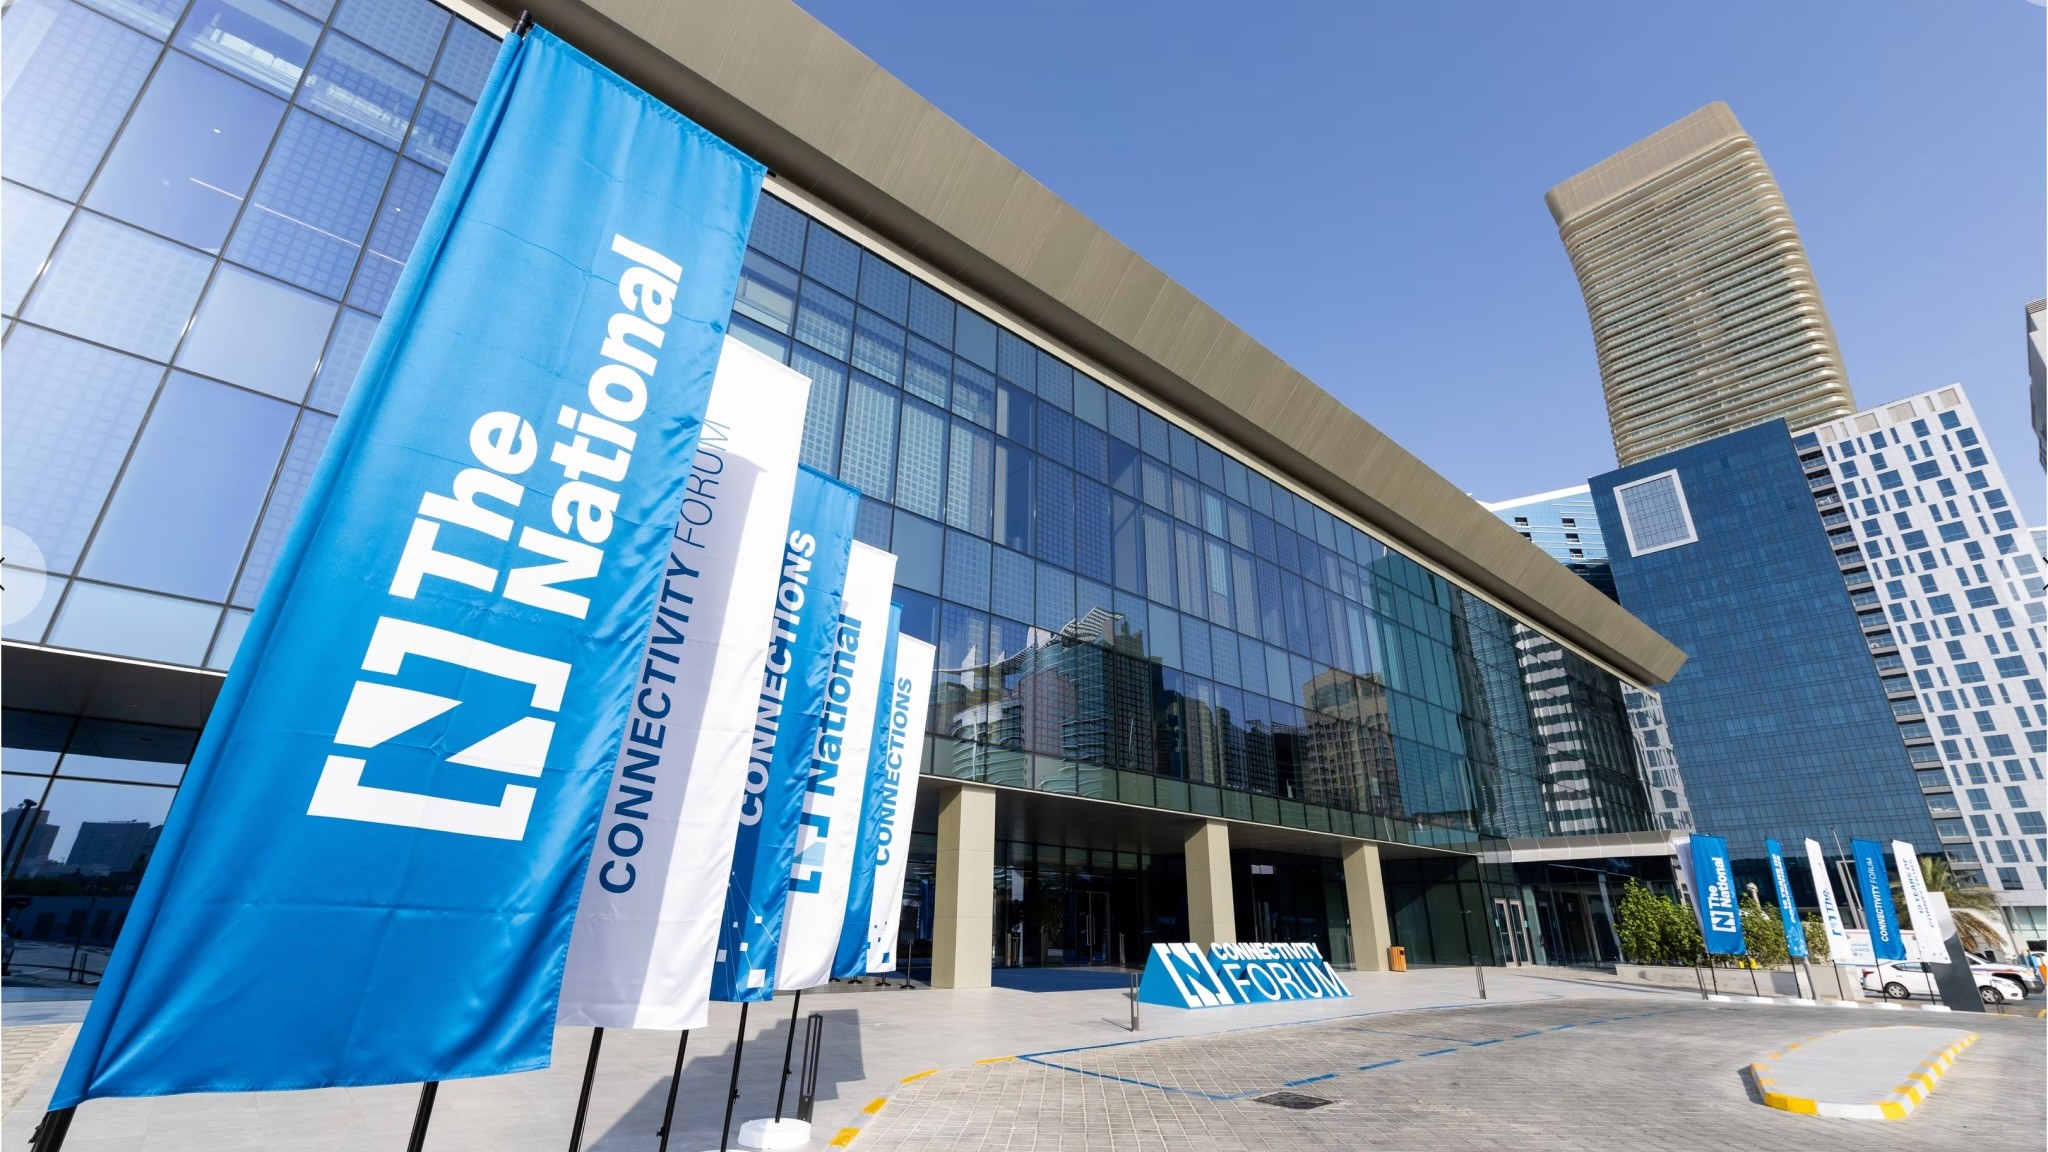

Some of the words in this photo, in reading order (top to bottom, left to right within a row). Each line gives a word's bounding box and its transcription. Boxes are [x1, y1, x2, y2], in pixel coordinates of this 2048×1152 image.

[502, 234, 683, 620] National
[388, 410, 538, 599] The
[599, 551, 700, 893] CONNECTIVITY
[674, 419, 731, 548] FORUM
[740, 529, 816, 826] CONNECTIONS
[806, 614, 862, 796] National
[875, 677, 912, 866] CONNECTIONS
[1708, 885, 1719, 909] The
[1711, 857, 1733, 908] National
[1865, 857, 1877, 883] FORUM
[1870, 885, 1889, 942] CONNECTIVITY
[1211, 942, 1323, 961] CONNECTIVITY
[1222, 961, 1353, 1004] FORUM
